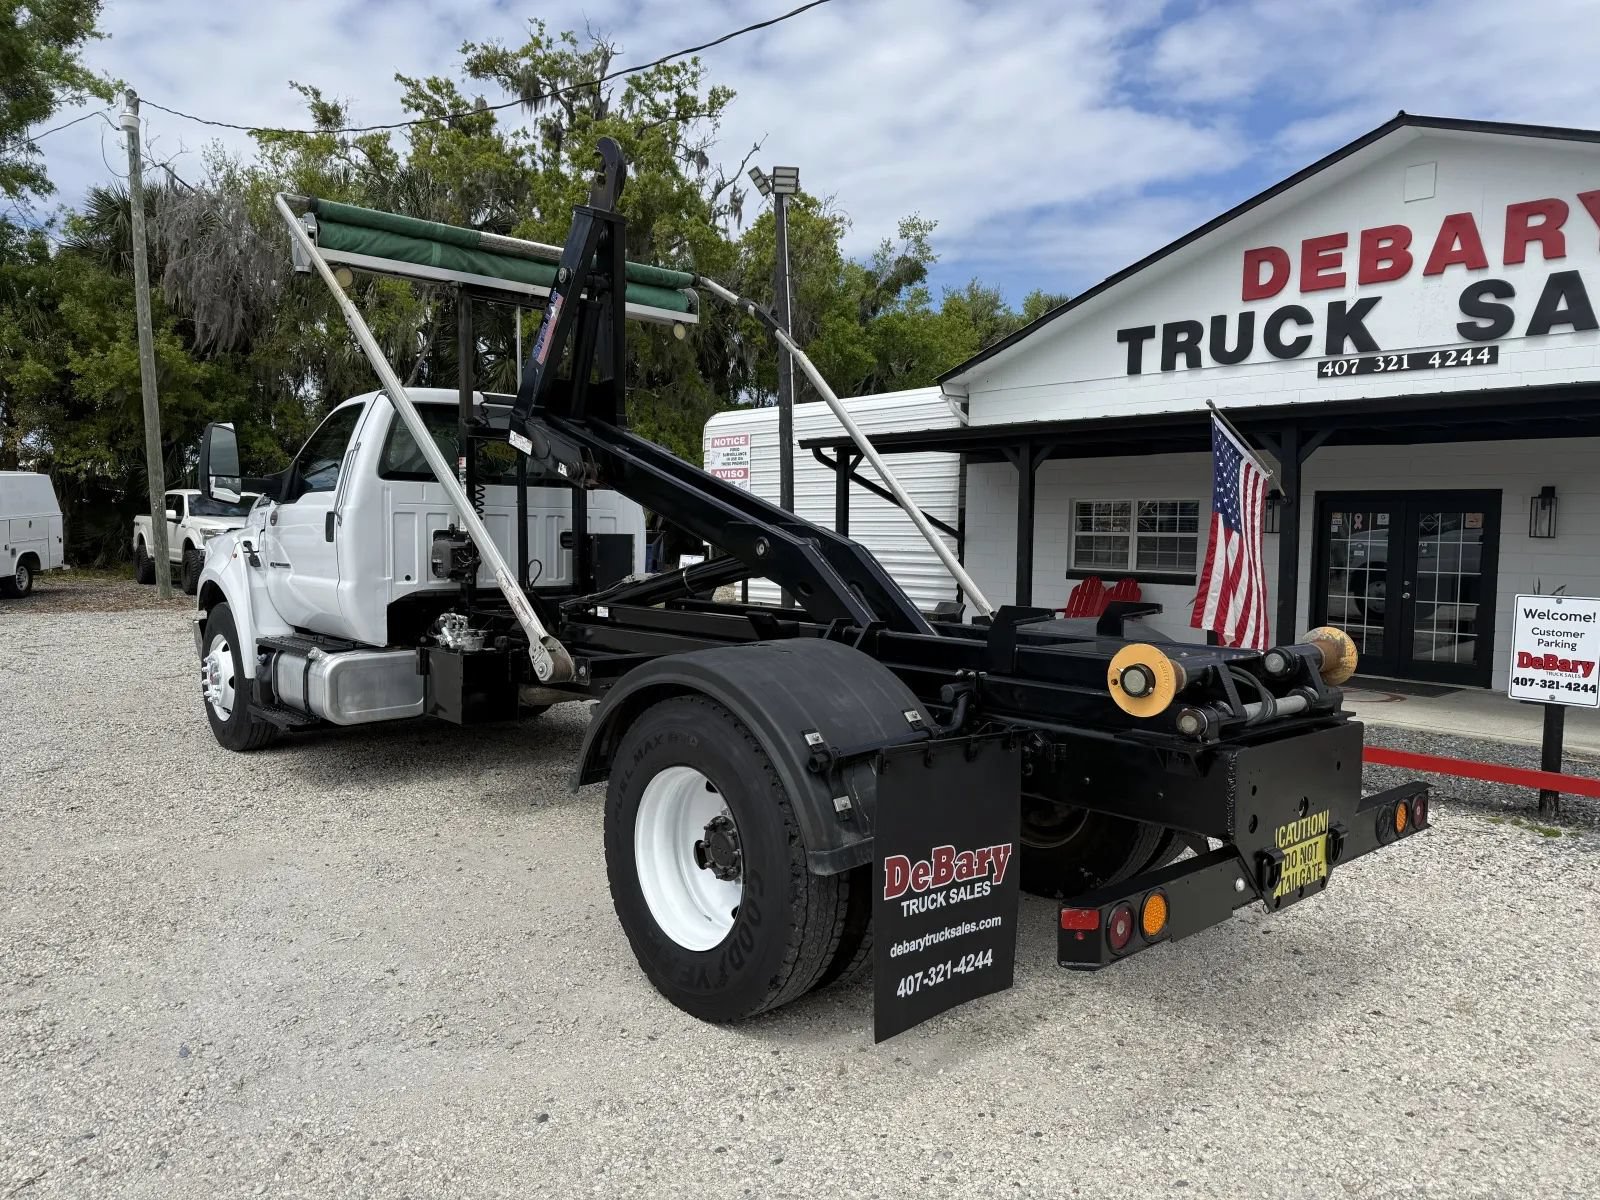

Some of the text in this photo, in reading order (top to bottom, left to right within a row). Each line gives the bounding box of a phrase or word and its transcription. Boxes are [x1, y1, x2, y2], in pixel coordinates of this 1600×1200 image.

[1117, 270, 1599, 375] TRUCK SA
[1322, 347, 1491, 377] 407 321 4244
[714, 437, 745, 447] NOTICE
[715, 470, 745, 478] AVISO
[1523, 608, 1596, 623] Welcome!
[1531, 627, 1585, 639] Customer
[1537, 639, 1577, 651] Parking
[1517, 651, 1595, 678] DeBary
[1513, 677, 1597, 693] 407-321-4244
[1279, 812, 1326, 848] CAUTION
[1284, 841, 1319, 872] DO NOT
[884, 843, 1012, 901] DeBary
[901, 880, 991, 918] TRUCK SALES
[890, 916, 1002, 958] debarytrucksales.com
[896, 949, 993, 999] 407-321-4244
